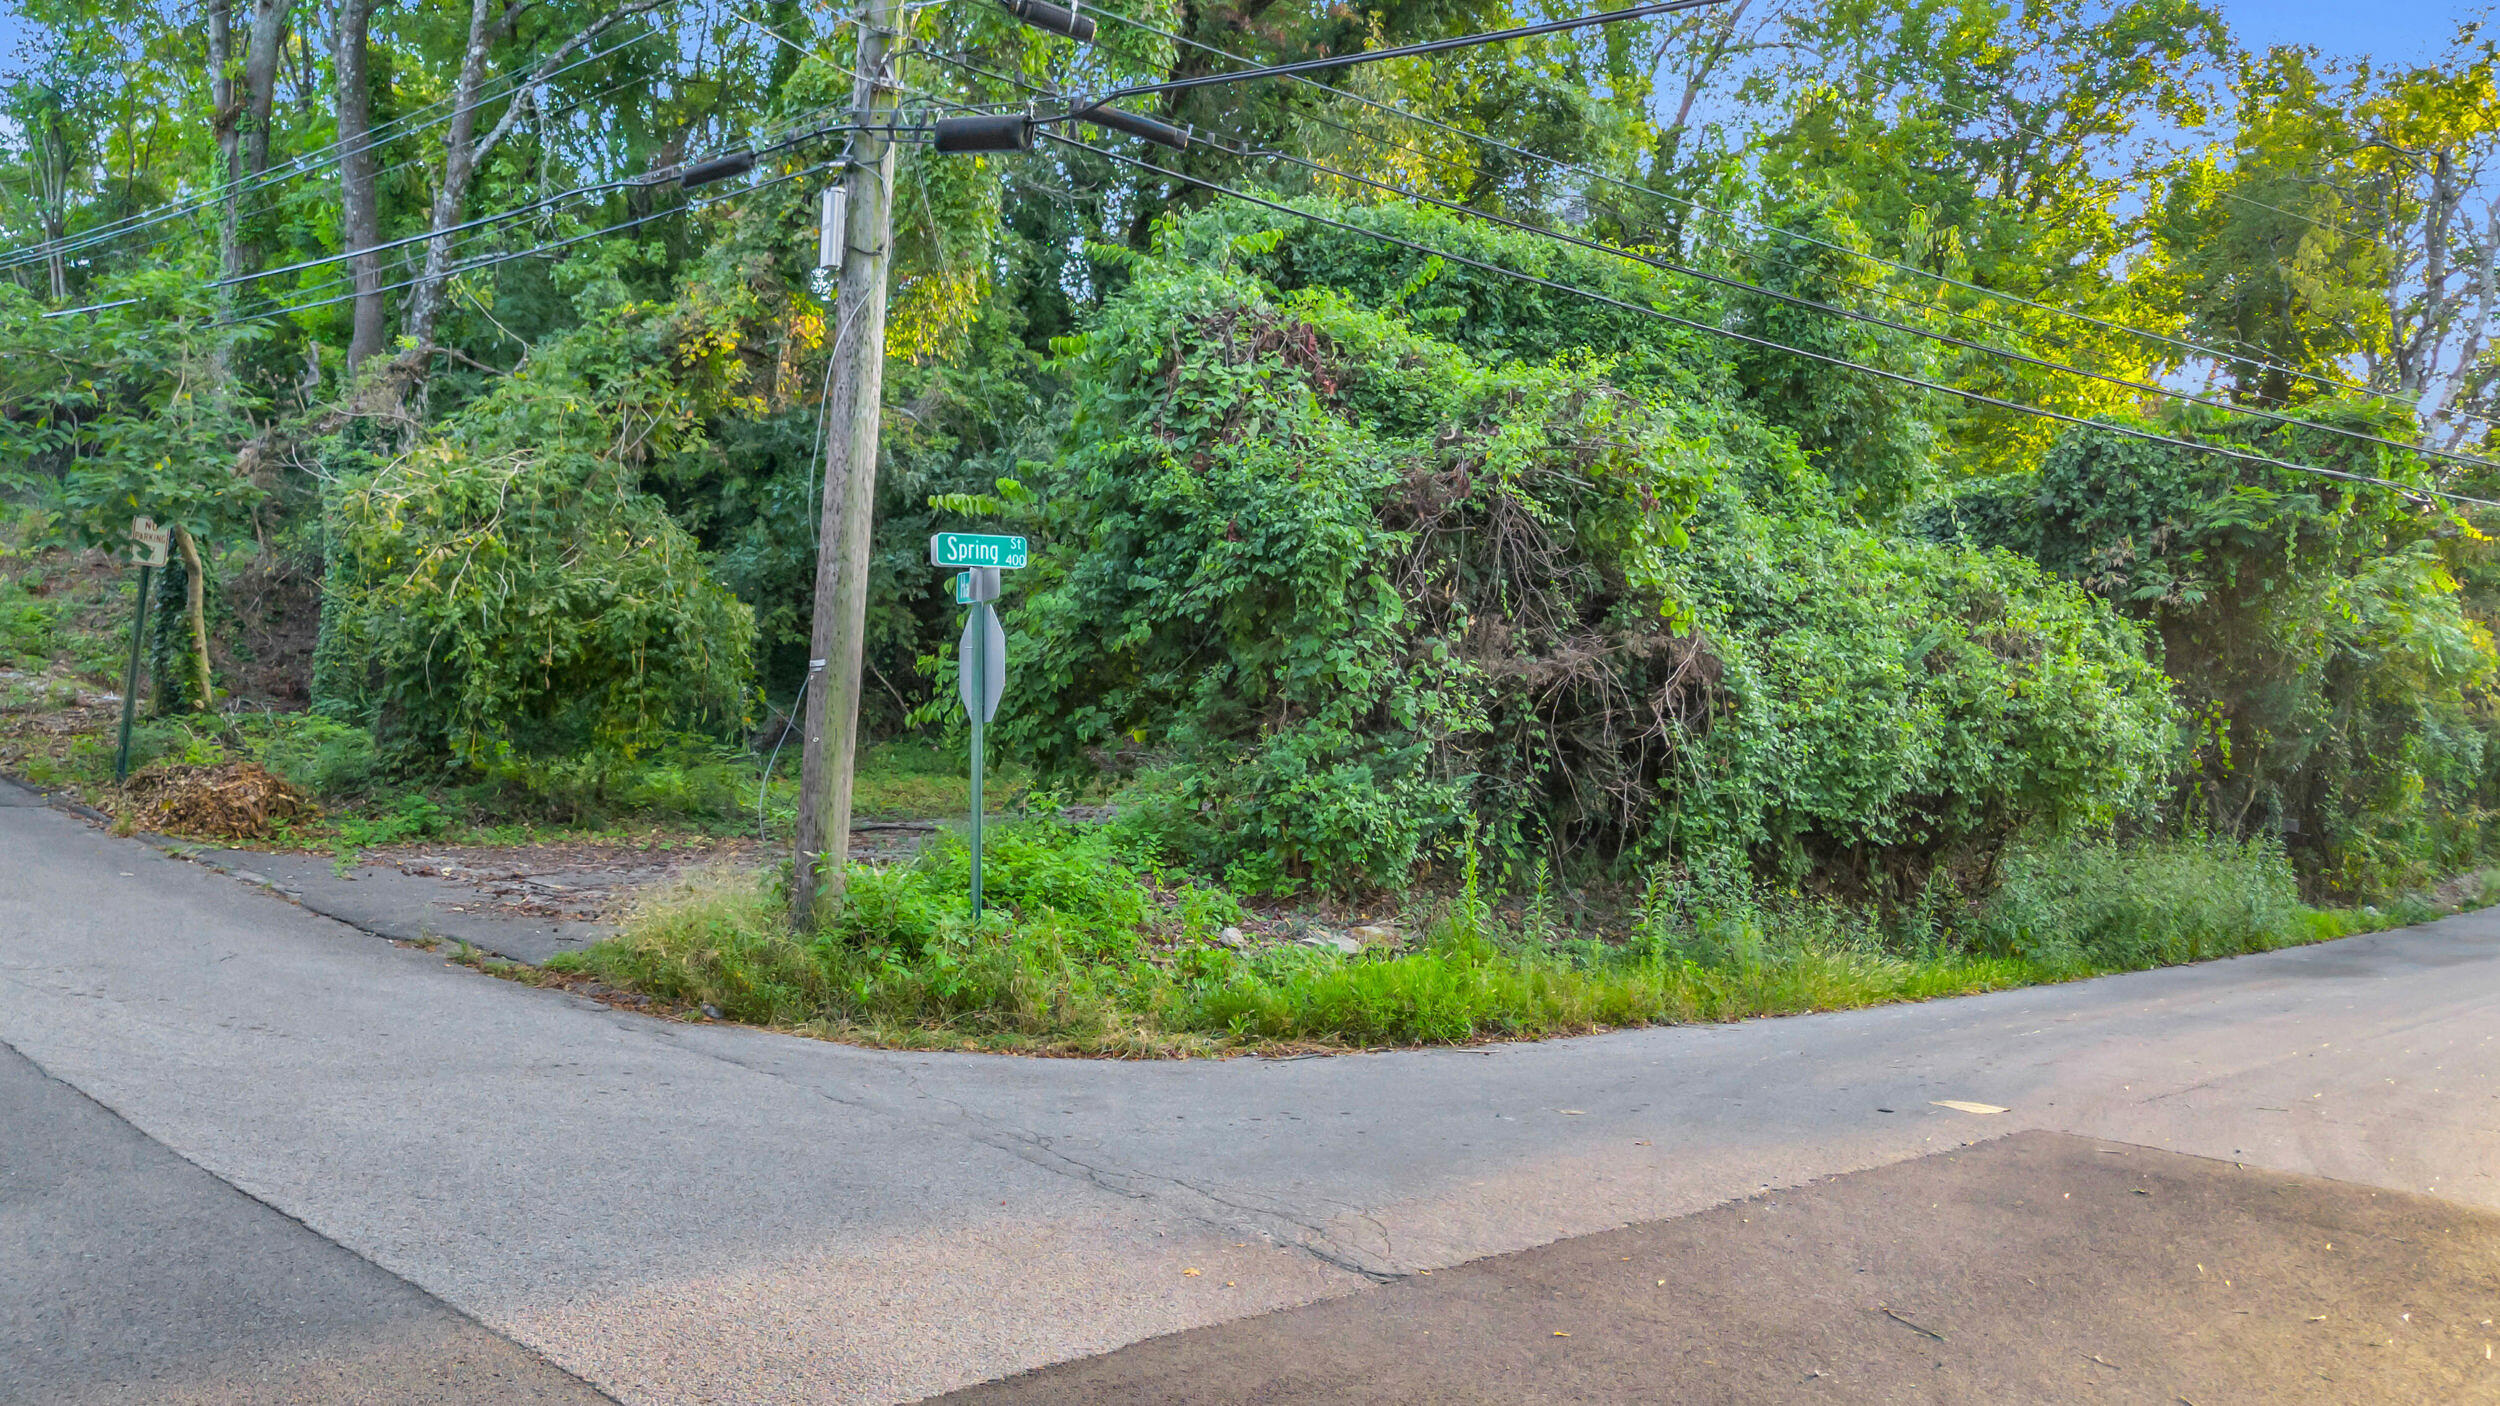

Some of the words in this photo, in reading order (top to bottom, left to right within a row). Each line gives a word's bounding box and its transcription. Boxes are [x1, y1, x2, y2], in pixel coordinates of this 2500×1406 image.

[134, 531, 165, 544] PARKING
[947, 535, 998, 564] Spring
[1010, 537, 1021, 550] St
[1005, 554, 1025, 566] 400
